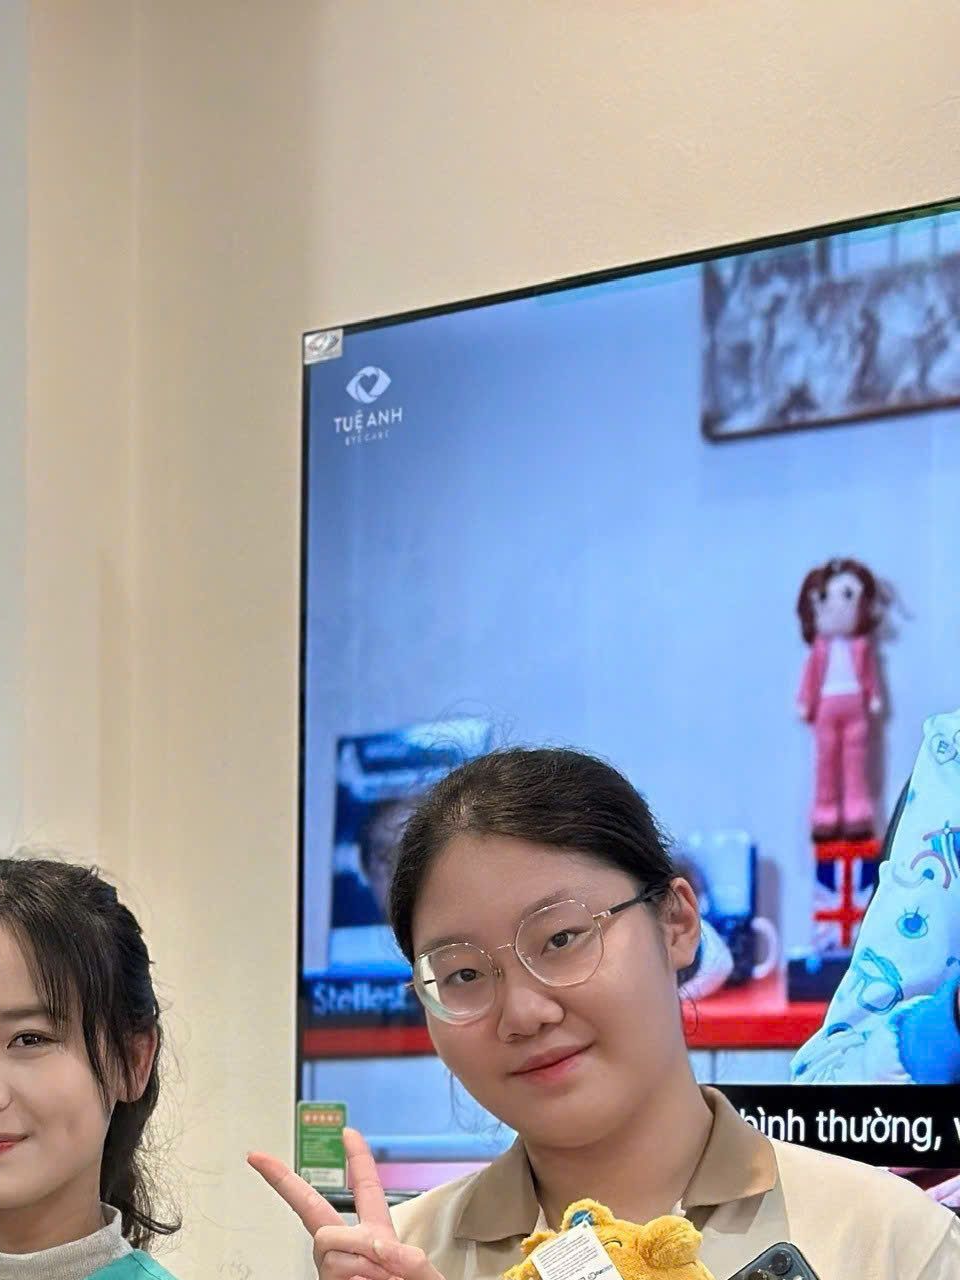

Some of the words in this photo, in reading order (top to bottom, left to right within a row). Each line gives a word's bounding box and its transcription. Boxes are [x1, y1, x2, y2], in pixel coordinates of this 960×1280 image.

[334, 409, 364, 434] TUỆ
[366, 407, 403, 428] ANH
[816, 1106, 942, 1152] thường,
